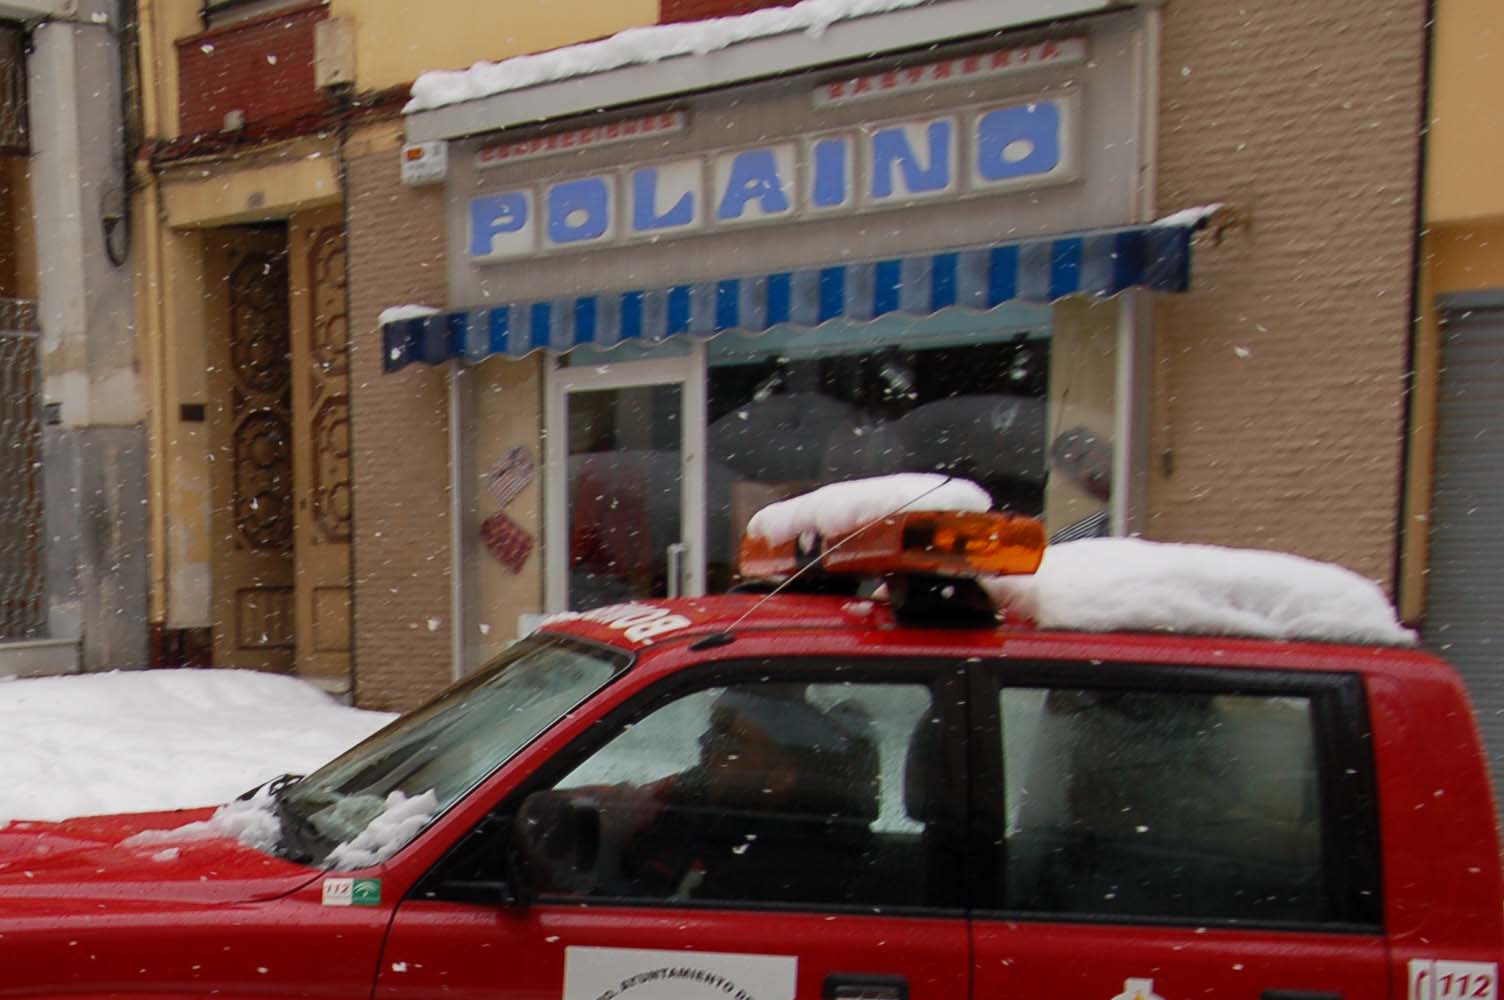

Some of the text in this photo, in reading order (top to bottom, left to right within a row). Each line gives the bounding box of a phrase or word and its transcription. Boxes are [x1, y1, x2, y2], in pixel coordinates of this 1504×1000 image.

[469, 100, 1060, 257] POLAINO
[620, 967, 735, 993] AYUNTAMIENTO
[1439, 972, 1491, 998] 112
